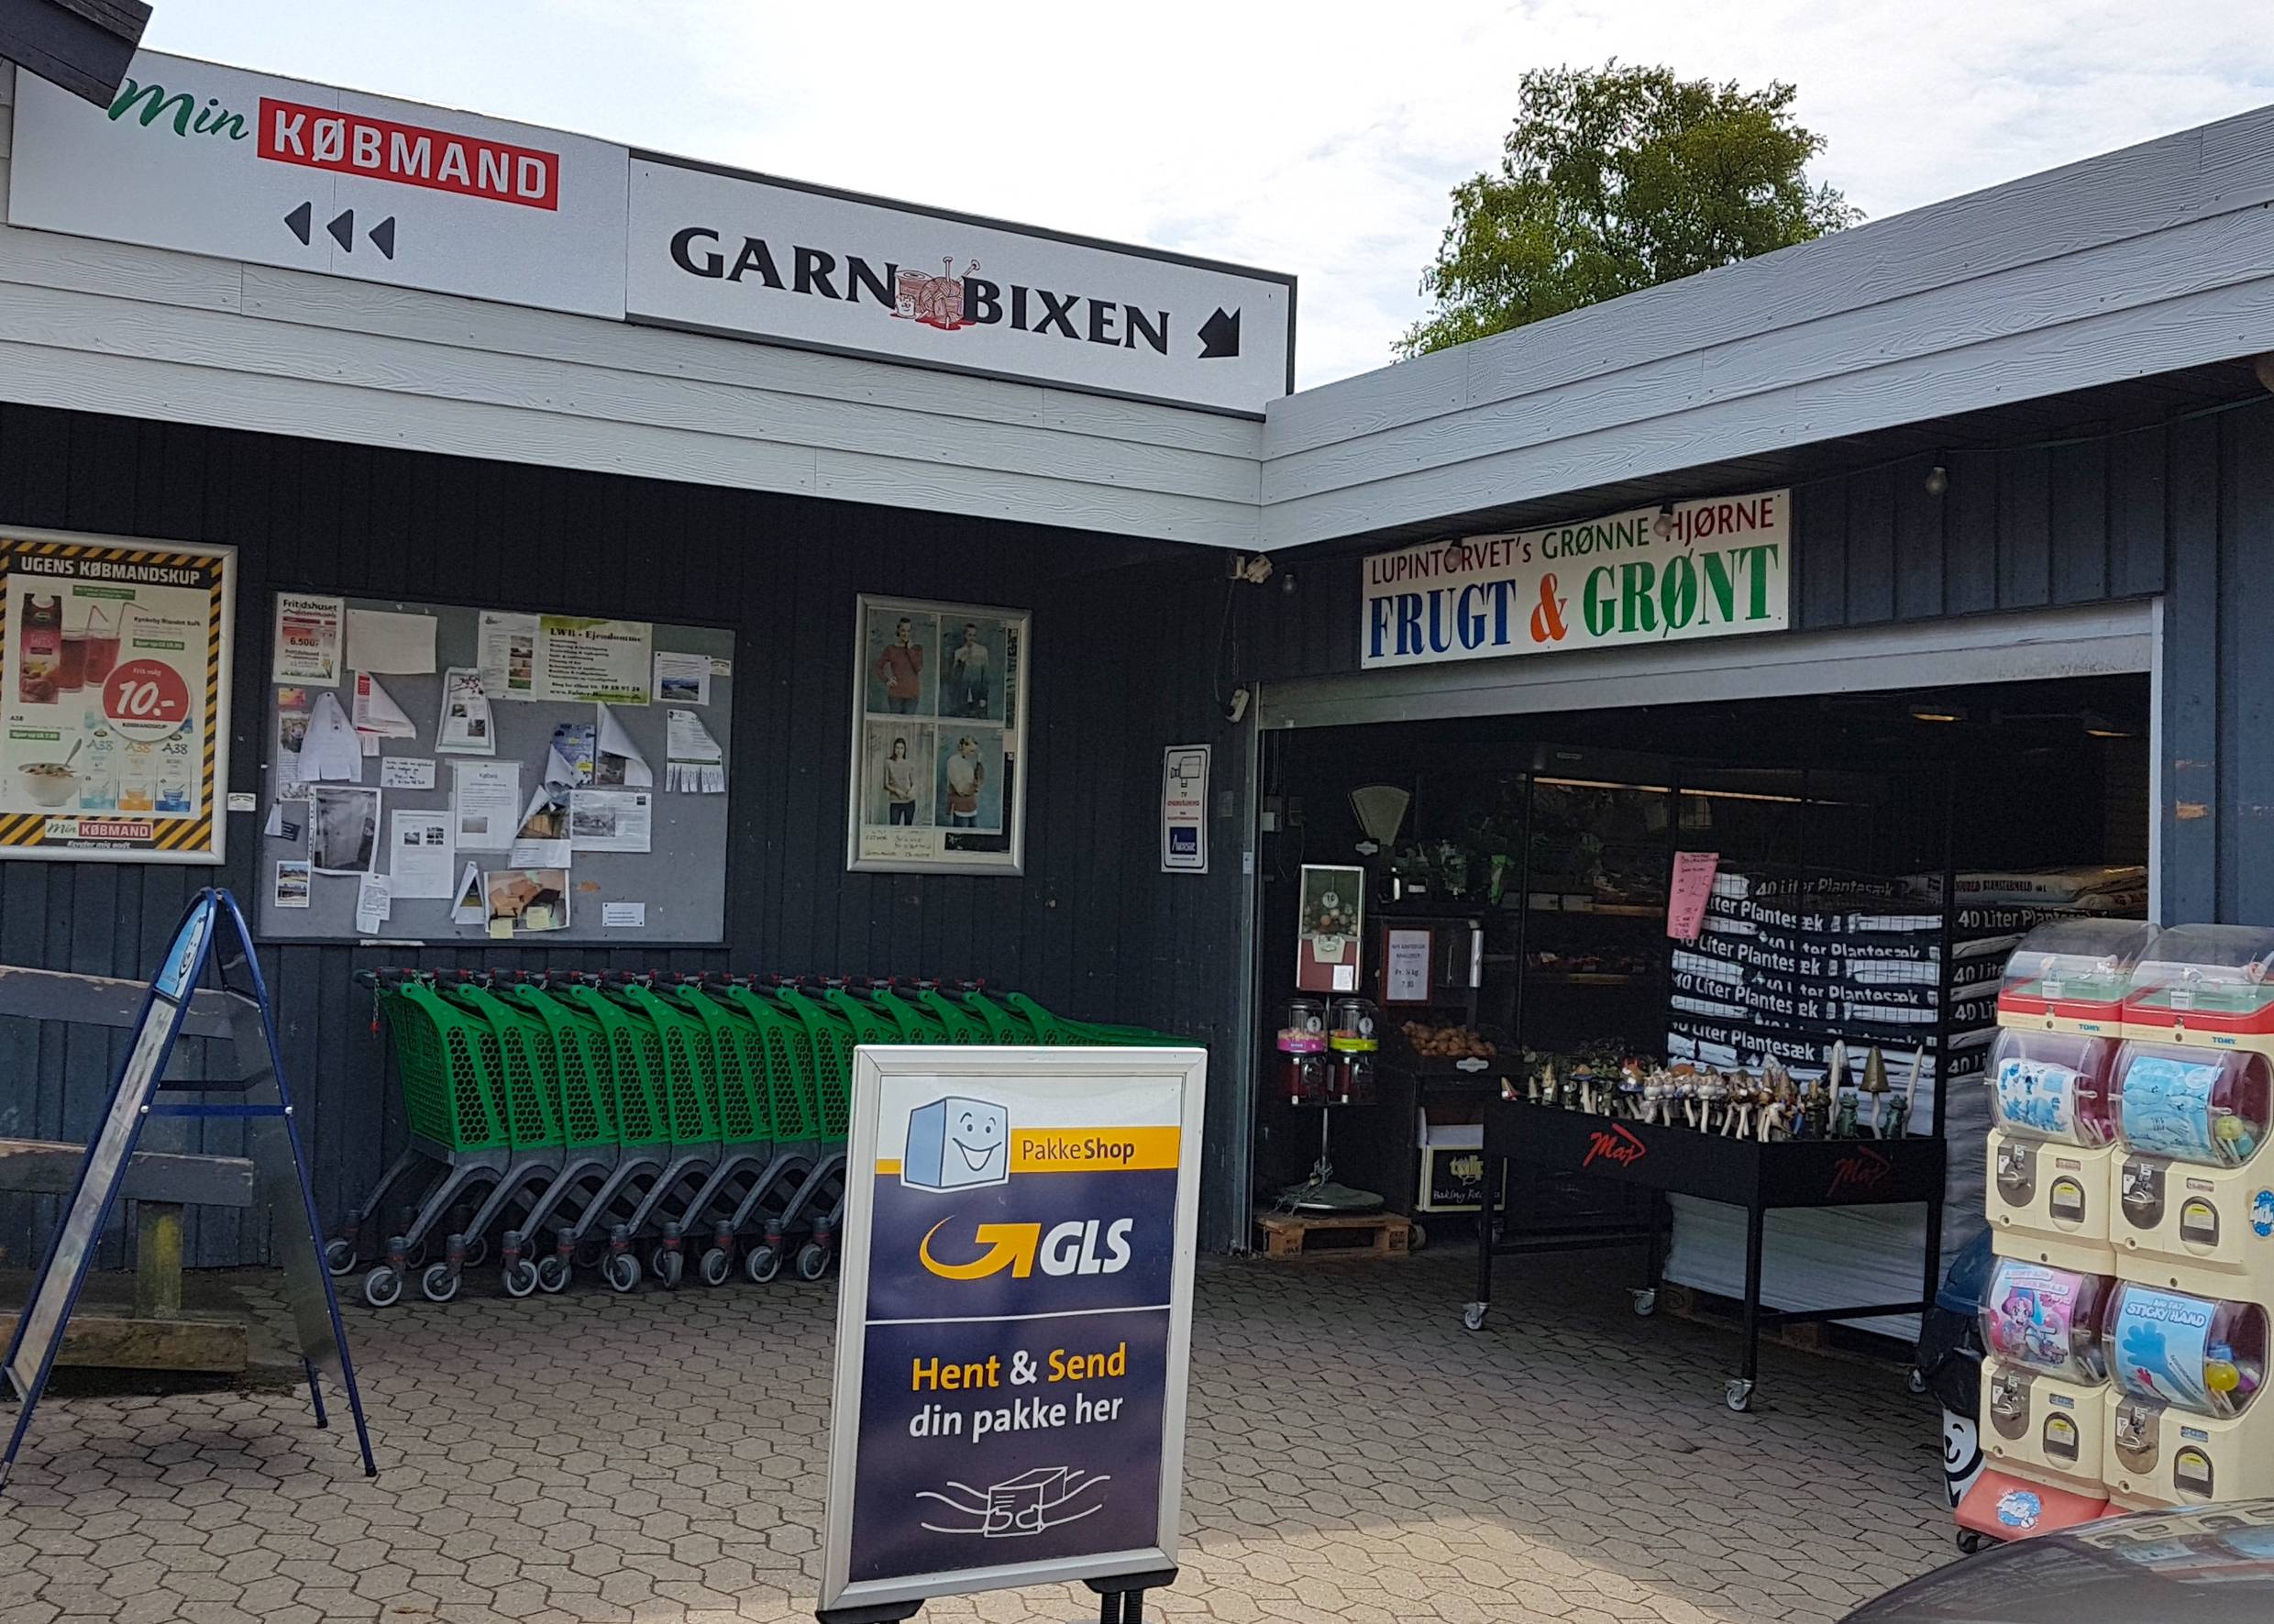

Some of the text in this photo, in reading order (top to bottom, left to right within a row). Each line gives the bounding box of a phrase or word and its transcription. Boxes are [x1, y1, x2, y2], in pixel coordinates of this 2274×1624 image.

[106, 78, 547, 200] Min KØBMAND
[670, 226, 1170, 356] GARN BIXEN
[1542, 516, 1649, 559] GRØNNE
[1666, 498, 1775, 547] HJØRNE
[21, 556, 200, 585] UGENS KØBMANDSKUP
[1367, 544, 1778, 658] FRUGT & GRØNT
[82, 824, 149, 837] KØBMAND
[1707, 898, 1735, 915] iter
[1959, 910, 1980, 928] 40
[1984, 910, 2018, 929] Liter
[1699, 935, 1734, 956] Liter
[1674, 973, 1692, 990] 40
[1696, 978, 1731, 1000] Liter
[1953, 963, 2004, 984] 40 Lite
[1955, 1001, 1999, 1022] 40 Lit
[2079, 1023, 2101, 1032] TOMY
[2213, 1036, 2237, 1044] TOMY
[1731, 1032, 1815, 1060] Plantesæk
[1022, 1137, 1134, 1164] PakkeShop
[1039, 1218, 1133, 1276] GLS
[2169, 1309, 2206, 1328] HAND
[912, 1342, 1126, 1391] Hent & Send
[909, 1392, 1123, 1443] din pakke her
